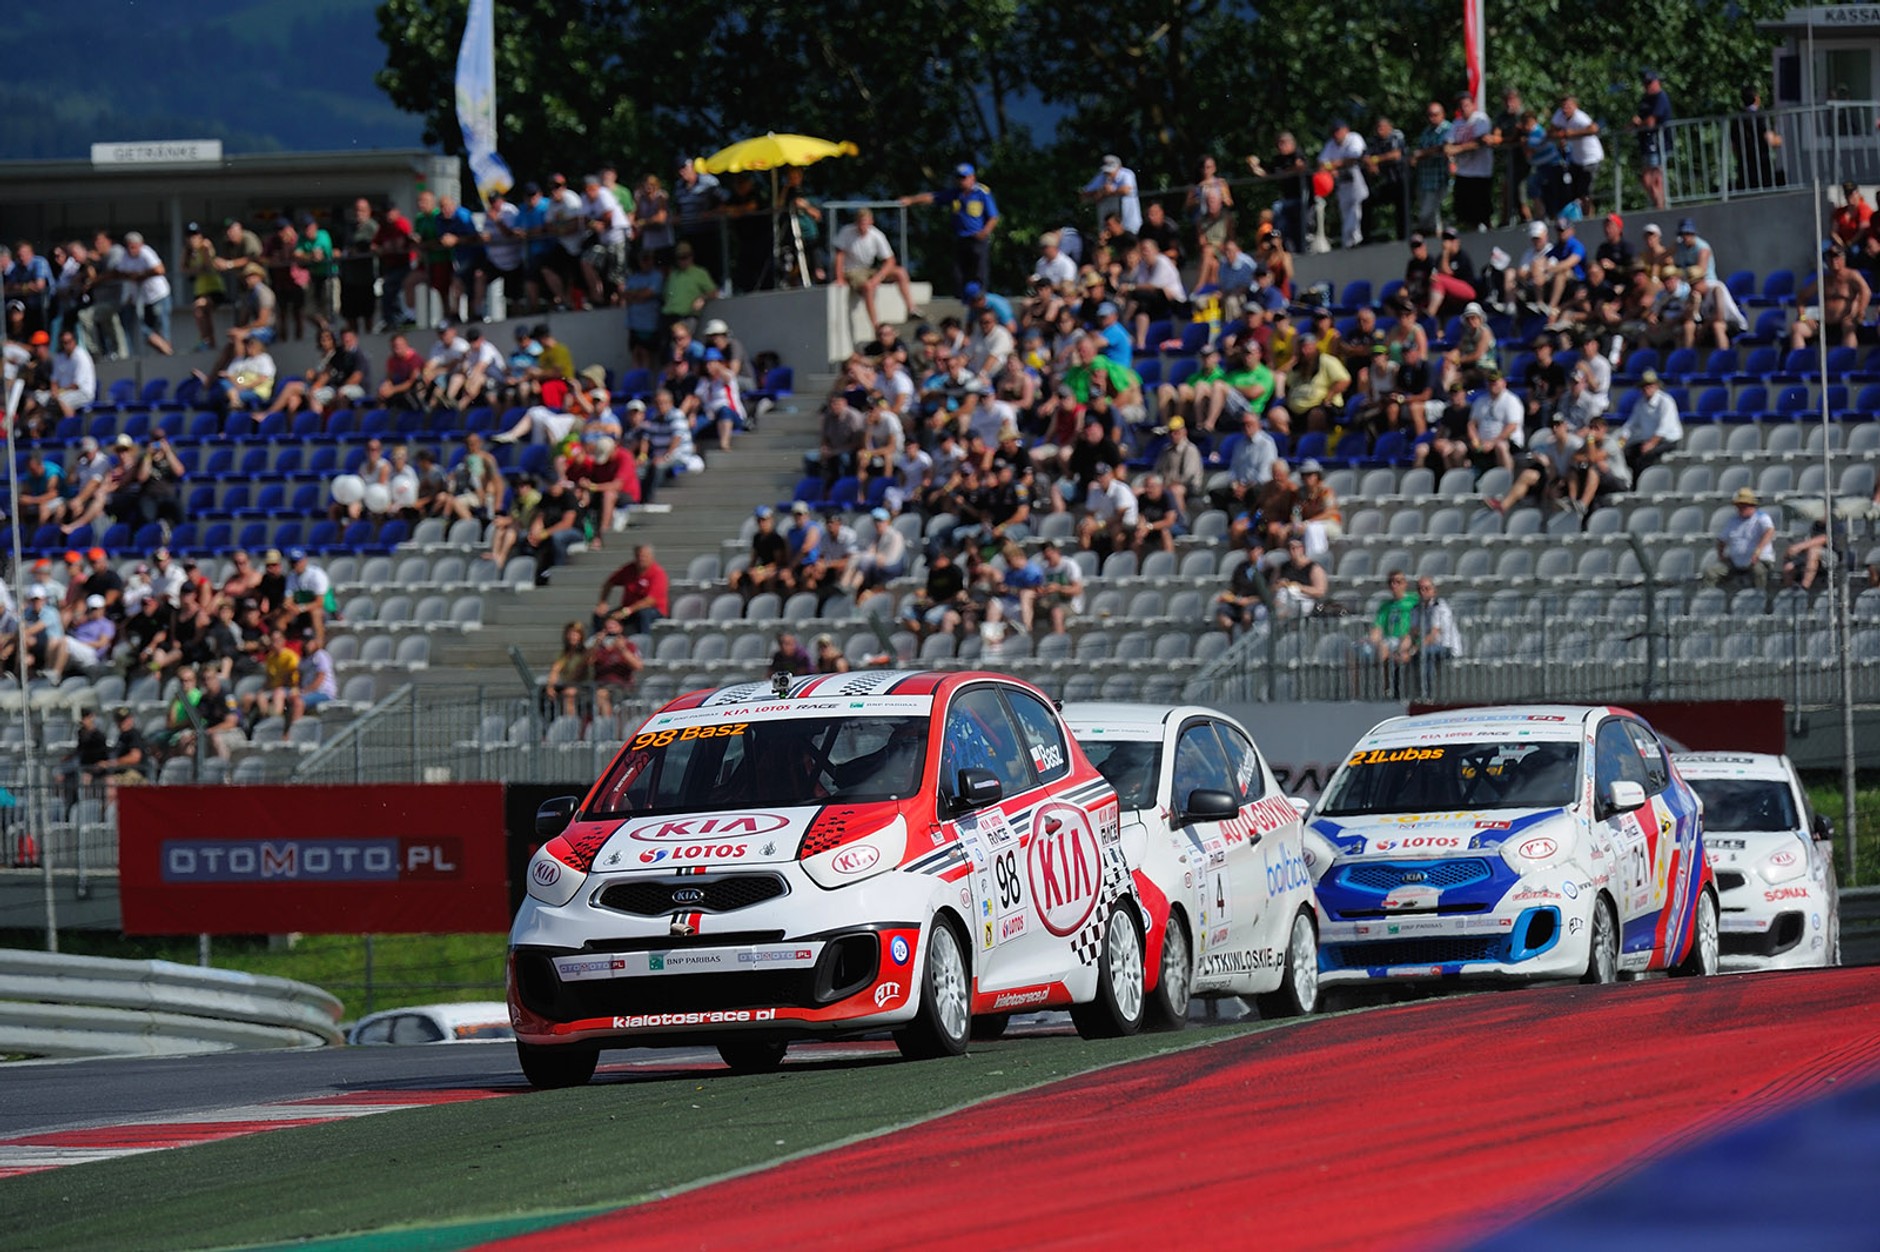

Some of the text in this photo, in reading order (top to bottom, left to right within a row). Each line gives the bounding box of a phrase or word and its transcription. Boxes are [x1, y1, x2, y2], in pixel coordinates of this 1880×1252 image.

[723, 702, 840, 716] KIA LOTOS RACE
[632, 722, 750, 750] 98 Basz
[654, 817, 757, 838] KIA
[671, 843, 748, 860] LOTOS
[1402, 837, 1460, 848] LOTOS
[535, 863, 554, 884] KIA
[1037, 828, 1092, 910] KIA
[996, 849, 1021, 909] 98
[676, 890, 699, 901] KIA
[1217, 873, 1225, 919] 4
[1764, 886, 1811, 902] SONAX
[686, 955, 721, 963] PARIBAS
